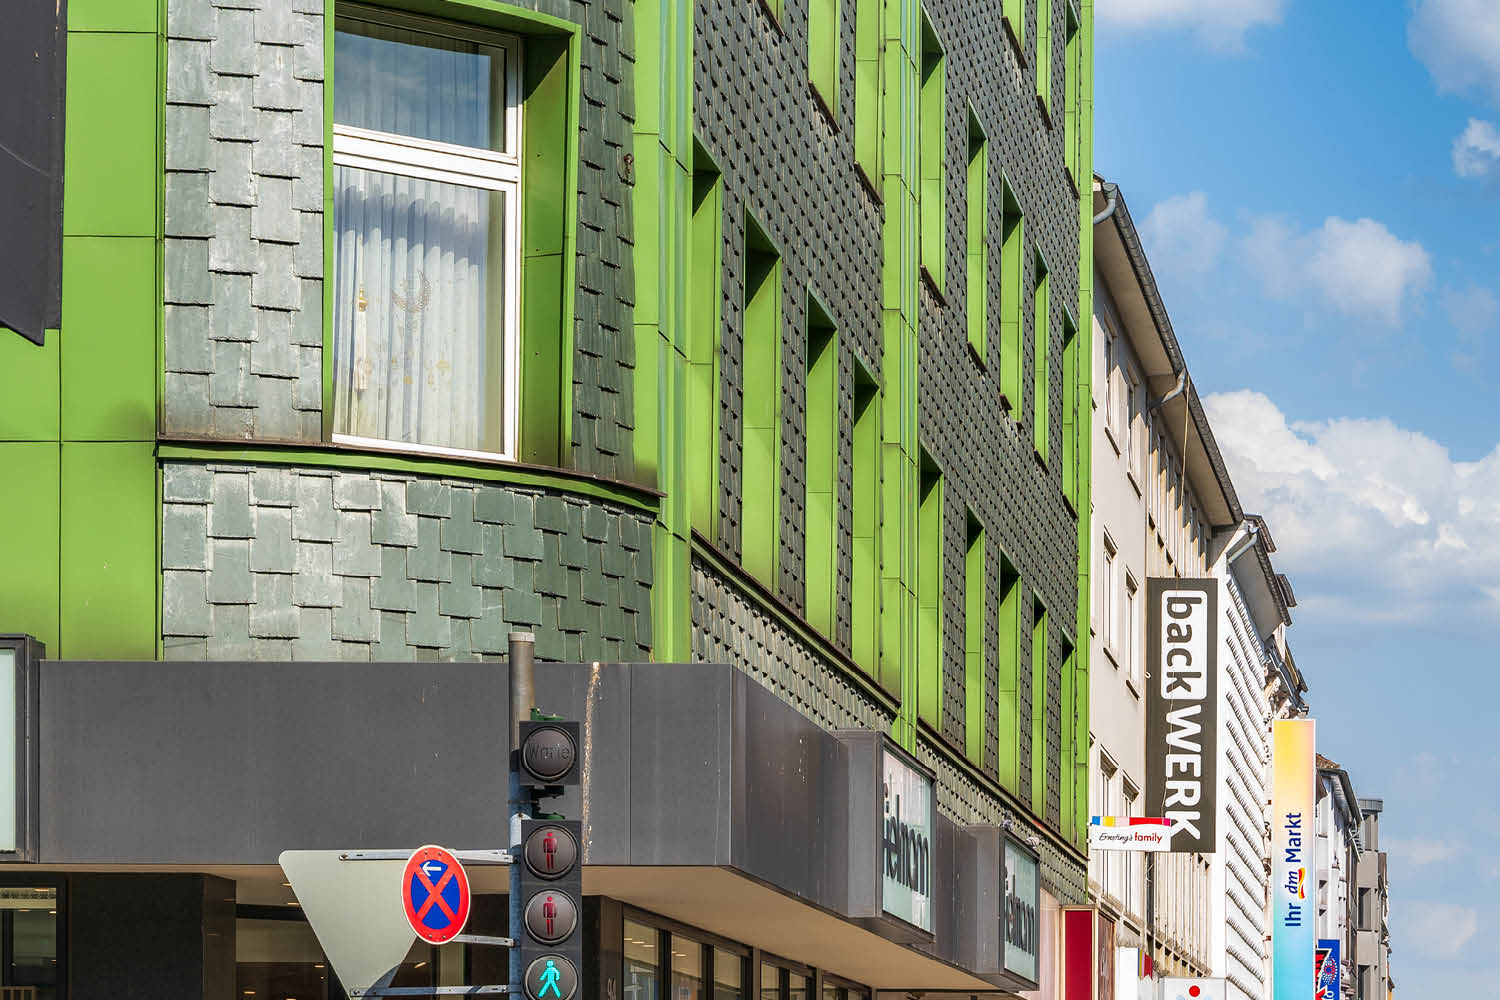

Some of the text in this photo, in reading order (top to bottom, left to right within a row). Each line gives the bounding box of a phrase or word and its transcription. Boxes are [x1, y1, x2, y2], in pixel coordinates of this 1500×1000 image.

[1098, 832, 1163, 844] Ernsting's family
[1285, 812, 1302, 927] Ihr dm Markt
